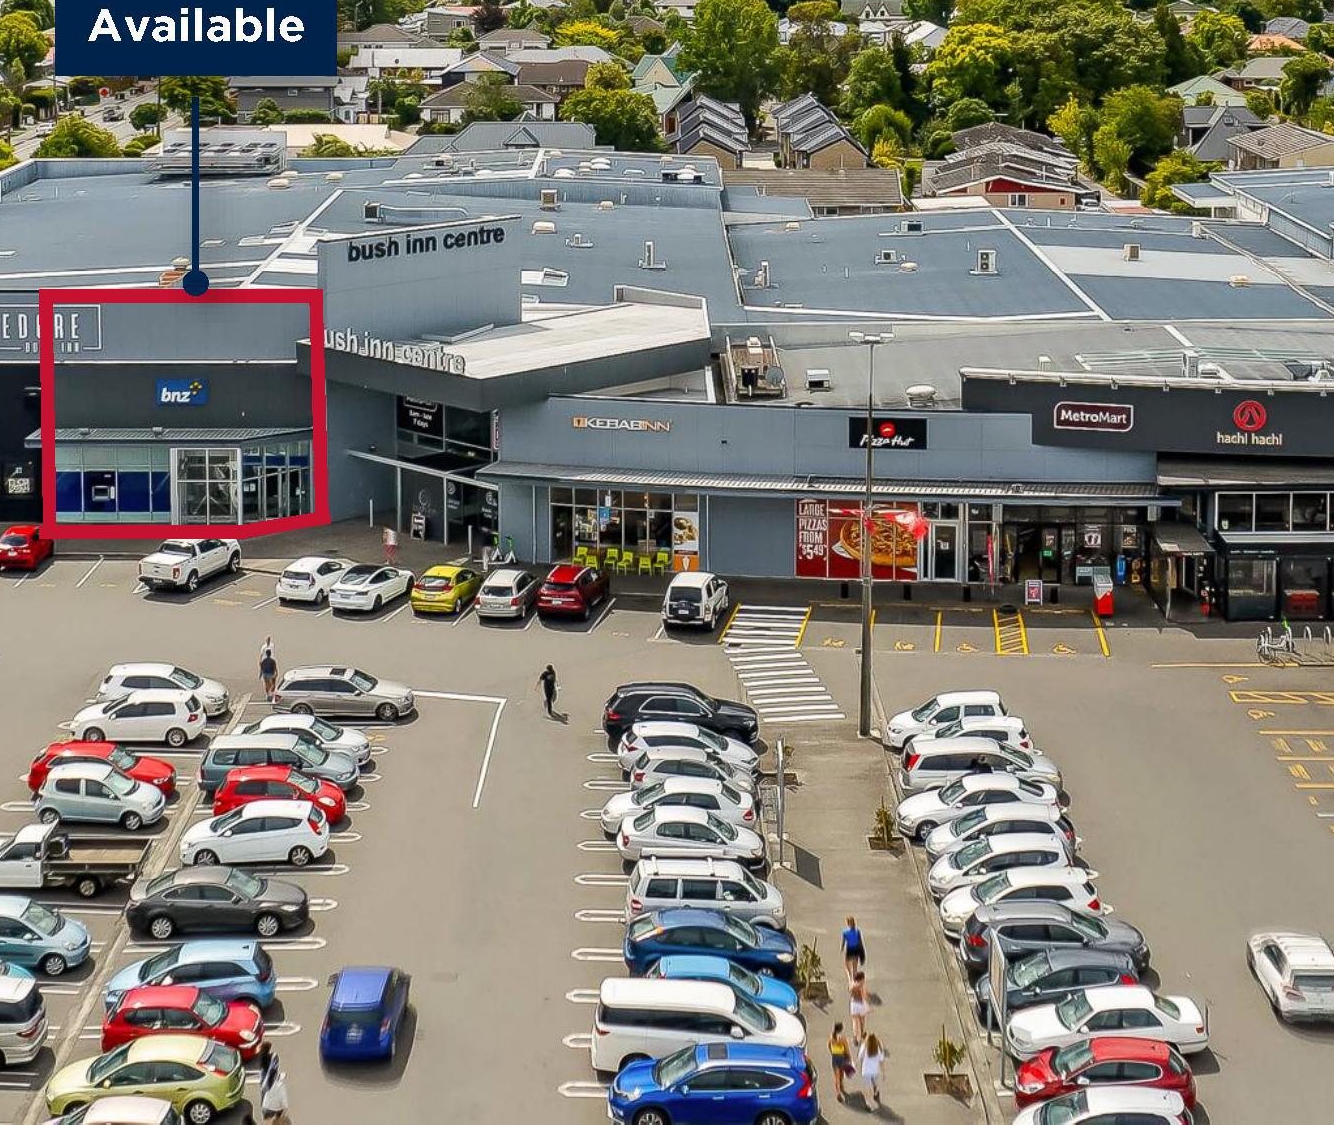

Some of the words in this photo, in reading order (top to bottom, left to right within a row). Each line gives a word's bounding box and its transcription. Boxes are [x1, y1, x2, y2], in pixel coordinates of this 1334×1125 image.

[347, 236, 400, 263] bush
[406, 234, 437, 255] inn
[442, 226, 506, 250] centre
[323, 327, 359, 352] ush
[360, 331, 395, 360] inn
[160, 386, 191, 403] bnz
[1060, 409, 1128, 424] MetroMart
[891, 435, 916, 447] Hut
[1217, 432, 1248, 445] hachi
[1251, 433, 1283, 446] hachi
[798, 503, 826, 516] LARGE
[798, 517, 828, 531] PIZZAS
[798, 531, 824, 544] FROM
